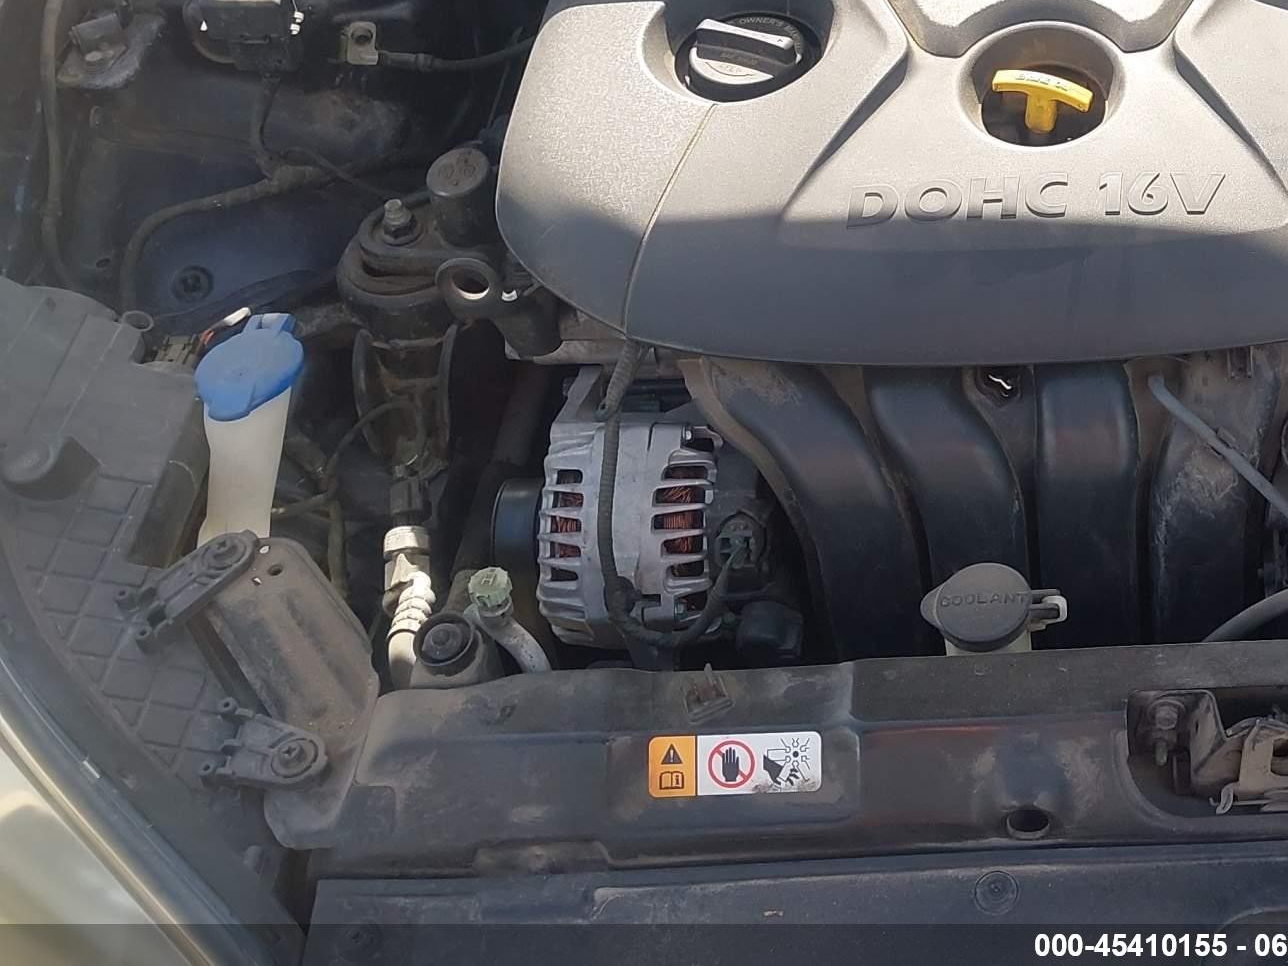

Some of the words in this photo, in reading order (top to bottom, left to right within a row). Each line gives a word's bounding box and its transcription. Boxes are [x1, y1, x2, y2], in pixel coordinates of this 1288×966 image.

[846, 172, 1070, 228] DOHC
[1099, 171, 1226, 216] 16V
[940, 593, 1028, 608] COOLANT
